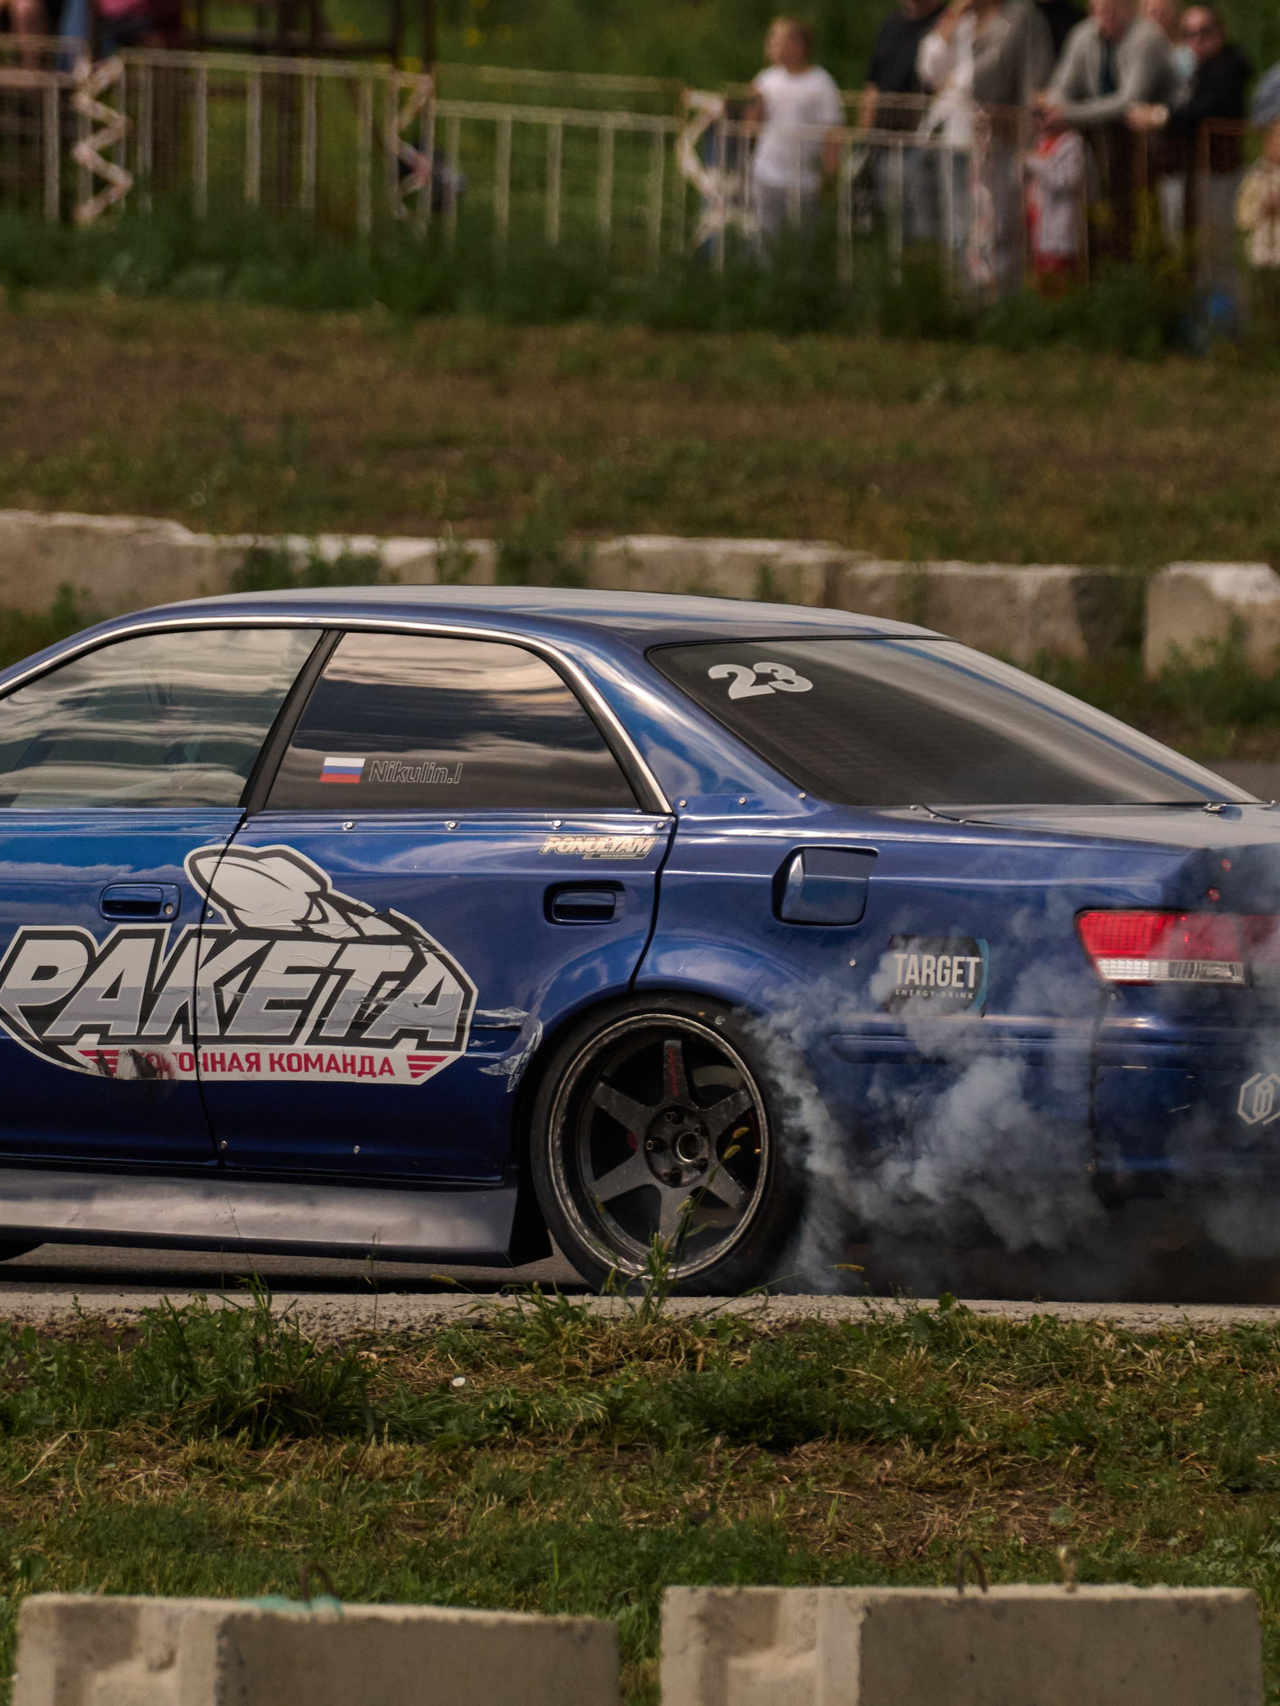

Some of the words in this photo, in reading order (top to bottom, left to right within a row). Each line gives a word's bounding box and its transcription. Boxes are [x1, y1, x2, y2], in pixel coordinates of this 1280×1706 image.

[707, 661, 814, 700] 23
[894, 953, 981, 989] TARGET
[895, 988, 935, 998] ENERGY
[941, 991, 974, 999] DRINK
[269, 1052, 395, 1078] КОМАНДА
